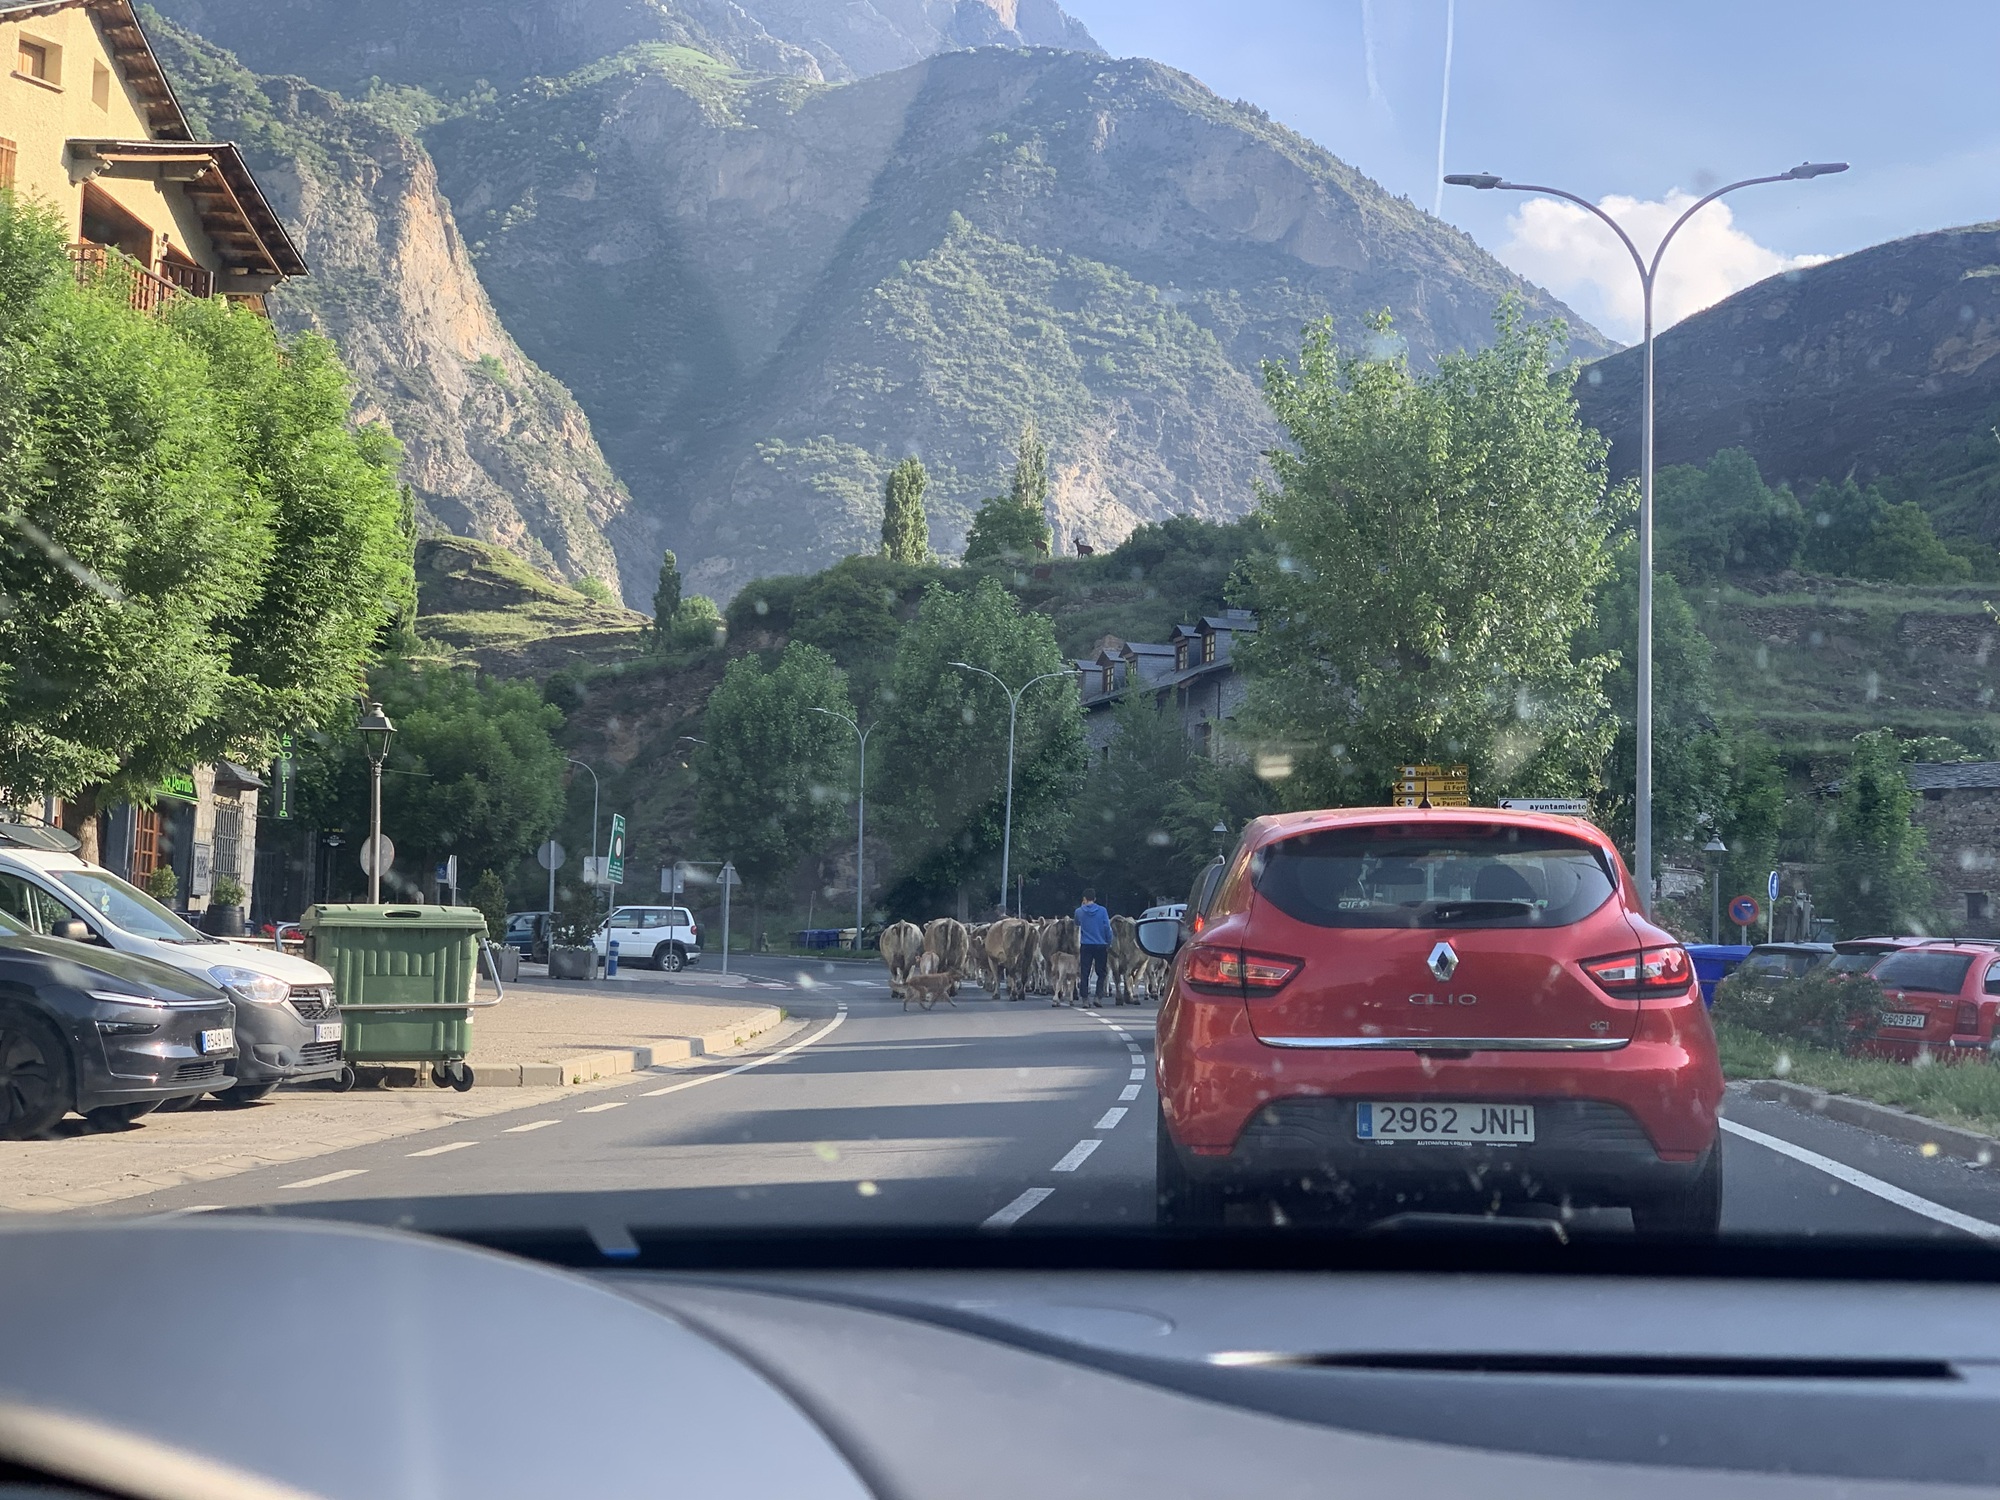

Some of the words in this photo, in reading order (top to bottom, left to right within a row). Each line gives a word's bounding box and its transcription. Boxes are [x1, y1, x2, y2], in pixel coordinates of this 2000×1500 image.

[1529, 802, 1587, 811] ayuntamiento
[1408, 993, 1477, 1005] CLIO
[1906, 1015, 1923, 1026] BPX
[206, 1033, 221, 1048] 8549
[1362, 1123, 1369, 1132] E
[1380, 1106, 1458, 1134] 2962
[1470, 1108, 1528, 1135] JNH
